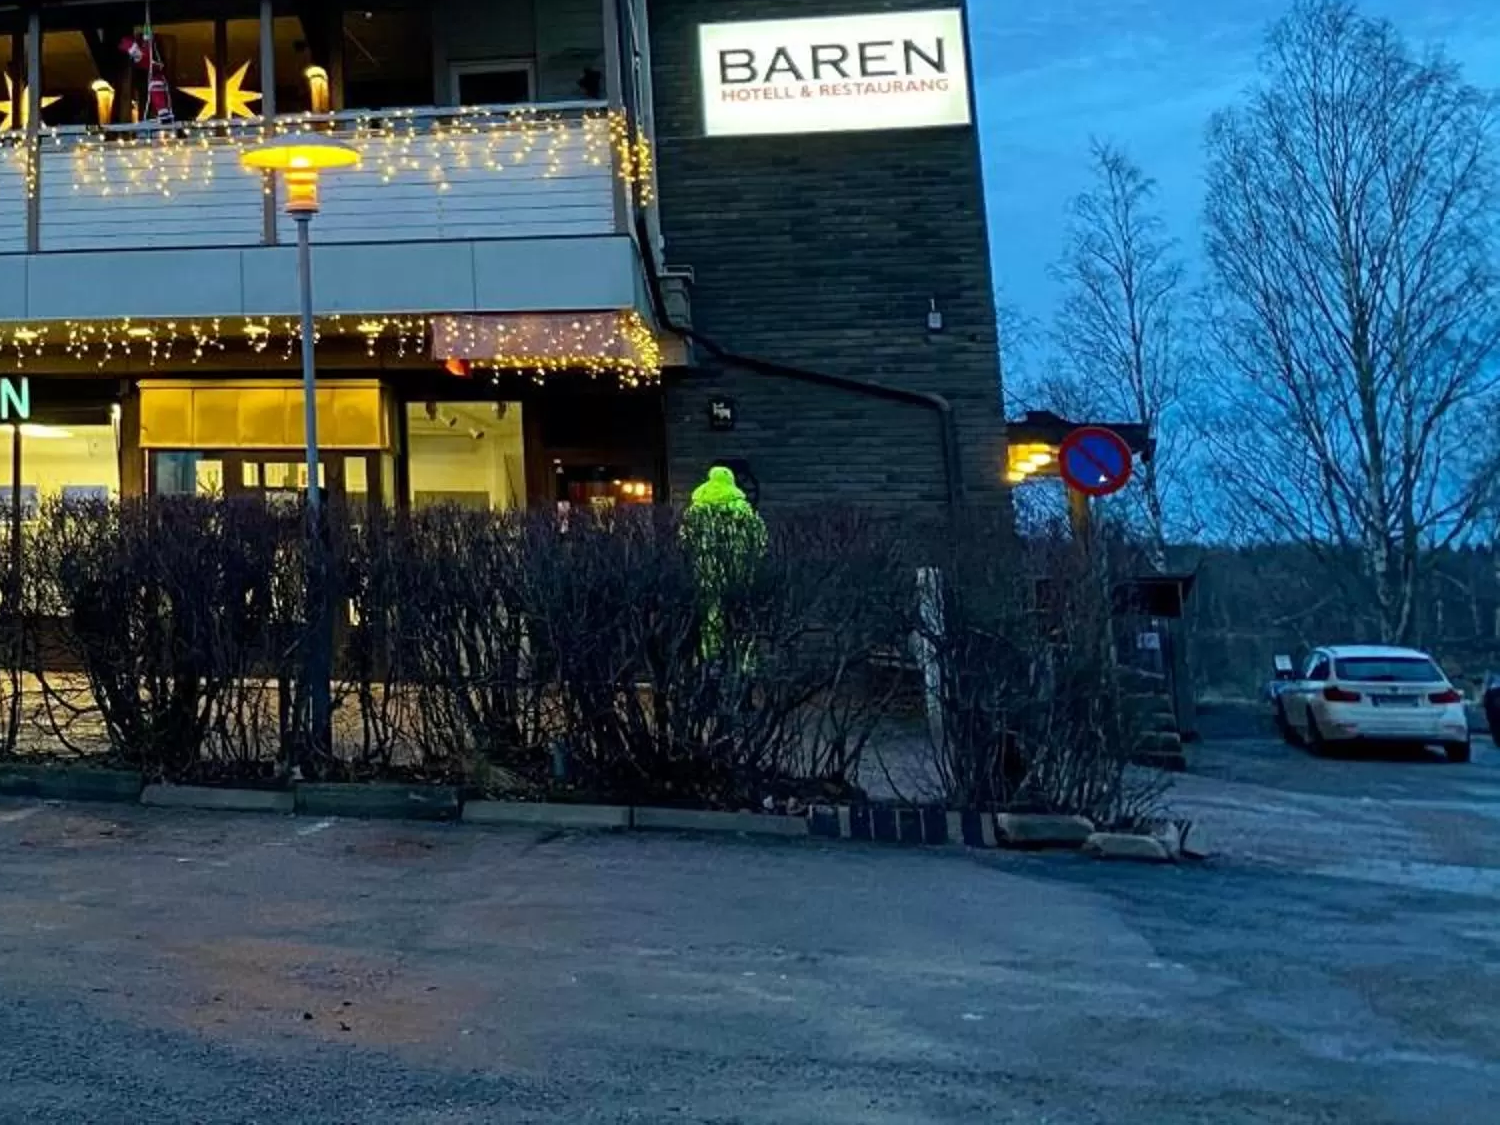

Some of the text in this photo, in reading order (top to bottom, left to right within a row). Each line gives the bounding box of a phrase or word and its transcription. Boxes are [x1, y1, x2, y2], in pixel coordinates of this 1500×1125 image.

[718, 37, 947, 85] BAREN
[720, 78, 949, 102] HOTELL & RESTAURANG
